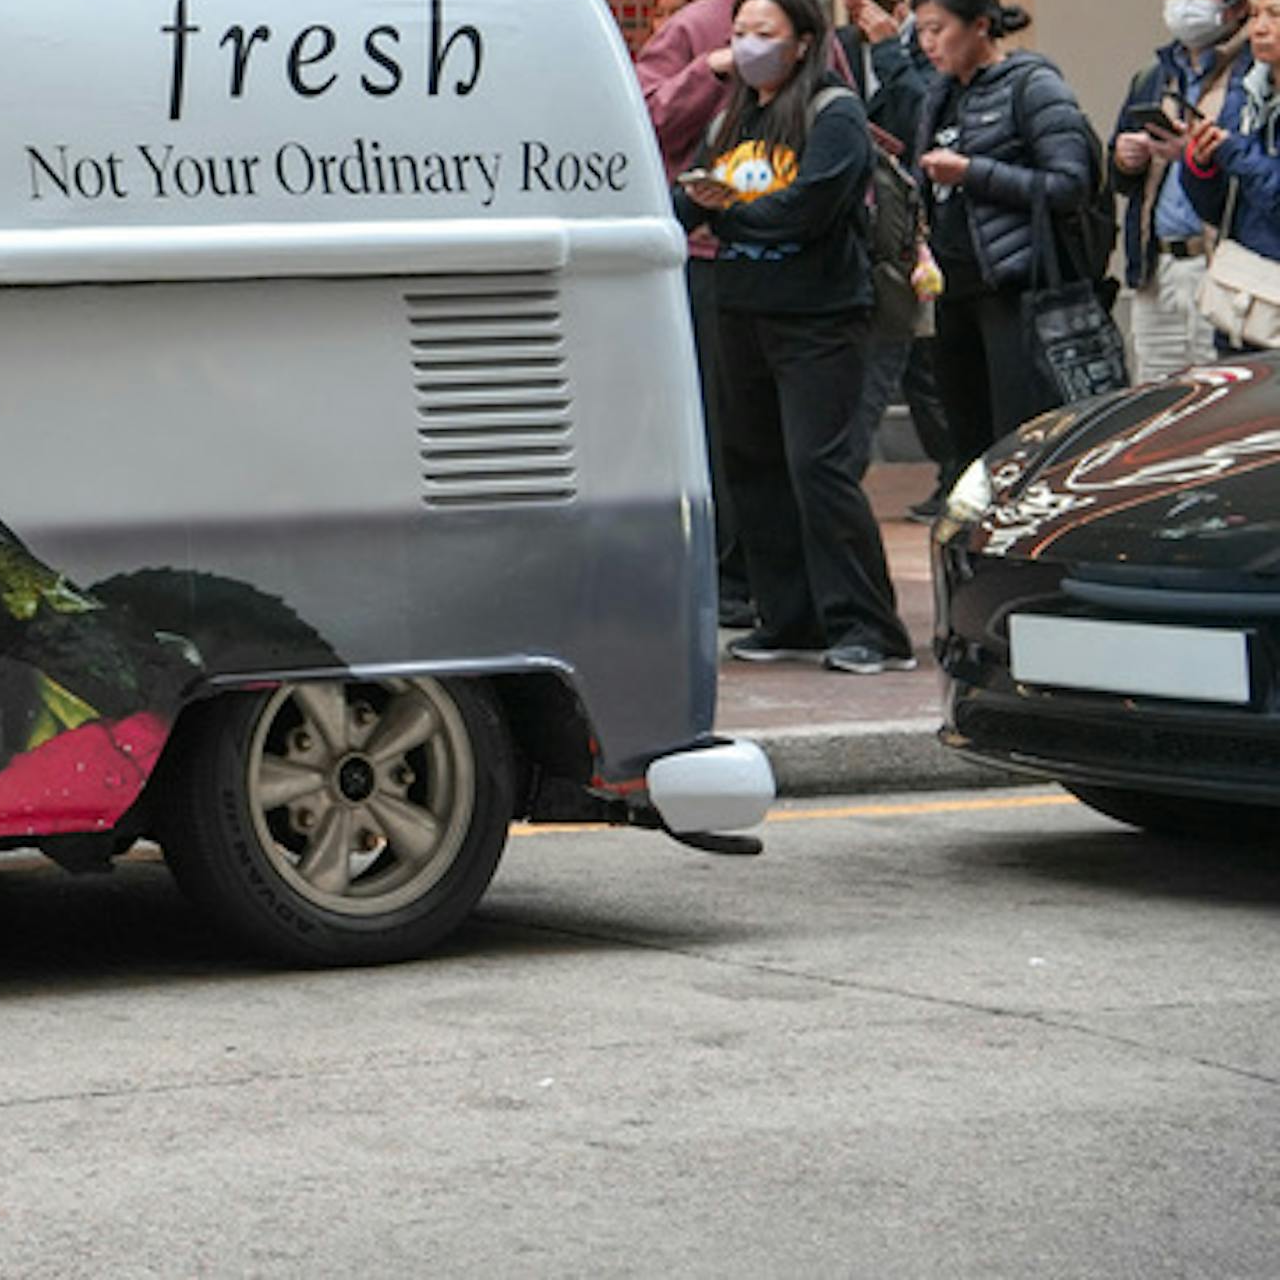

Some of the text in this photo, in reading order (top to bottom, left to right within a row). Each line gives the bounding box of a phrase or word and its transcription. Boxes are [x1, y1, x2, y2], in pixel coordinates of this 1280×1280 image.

[26, 138, 629, 206] Not Your Ordinary Rose
